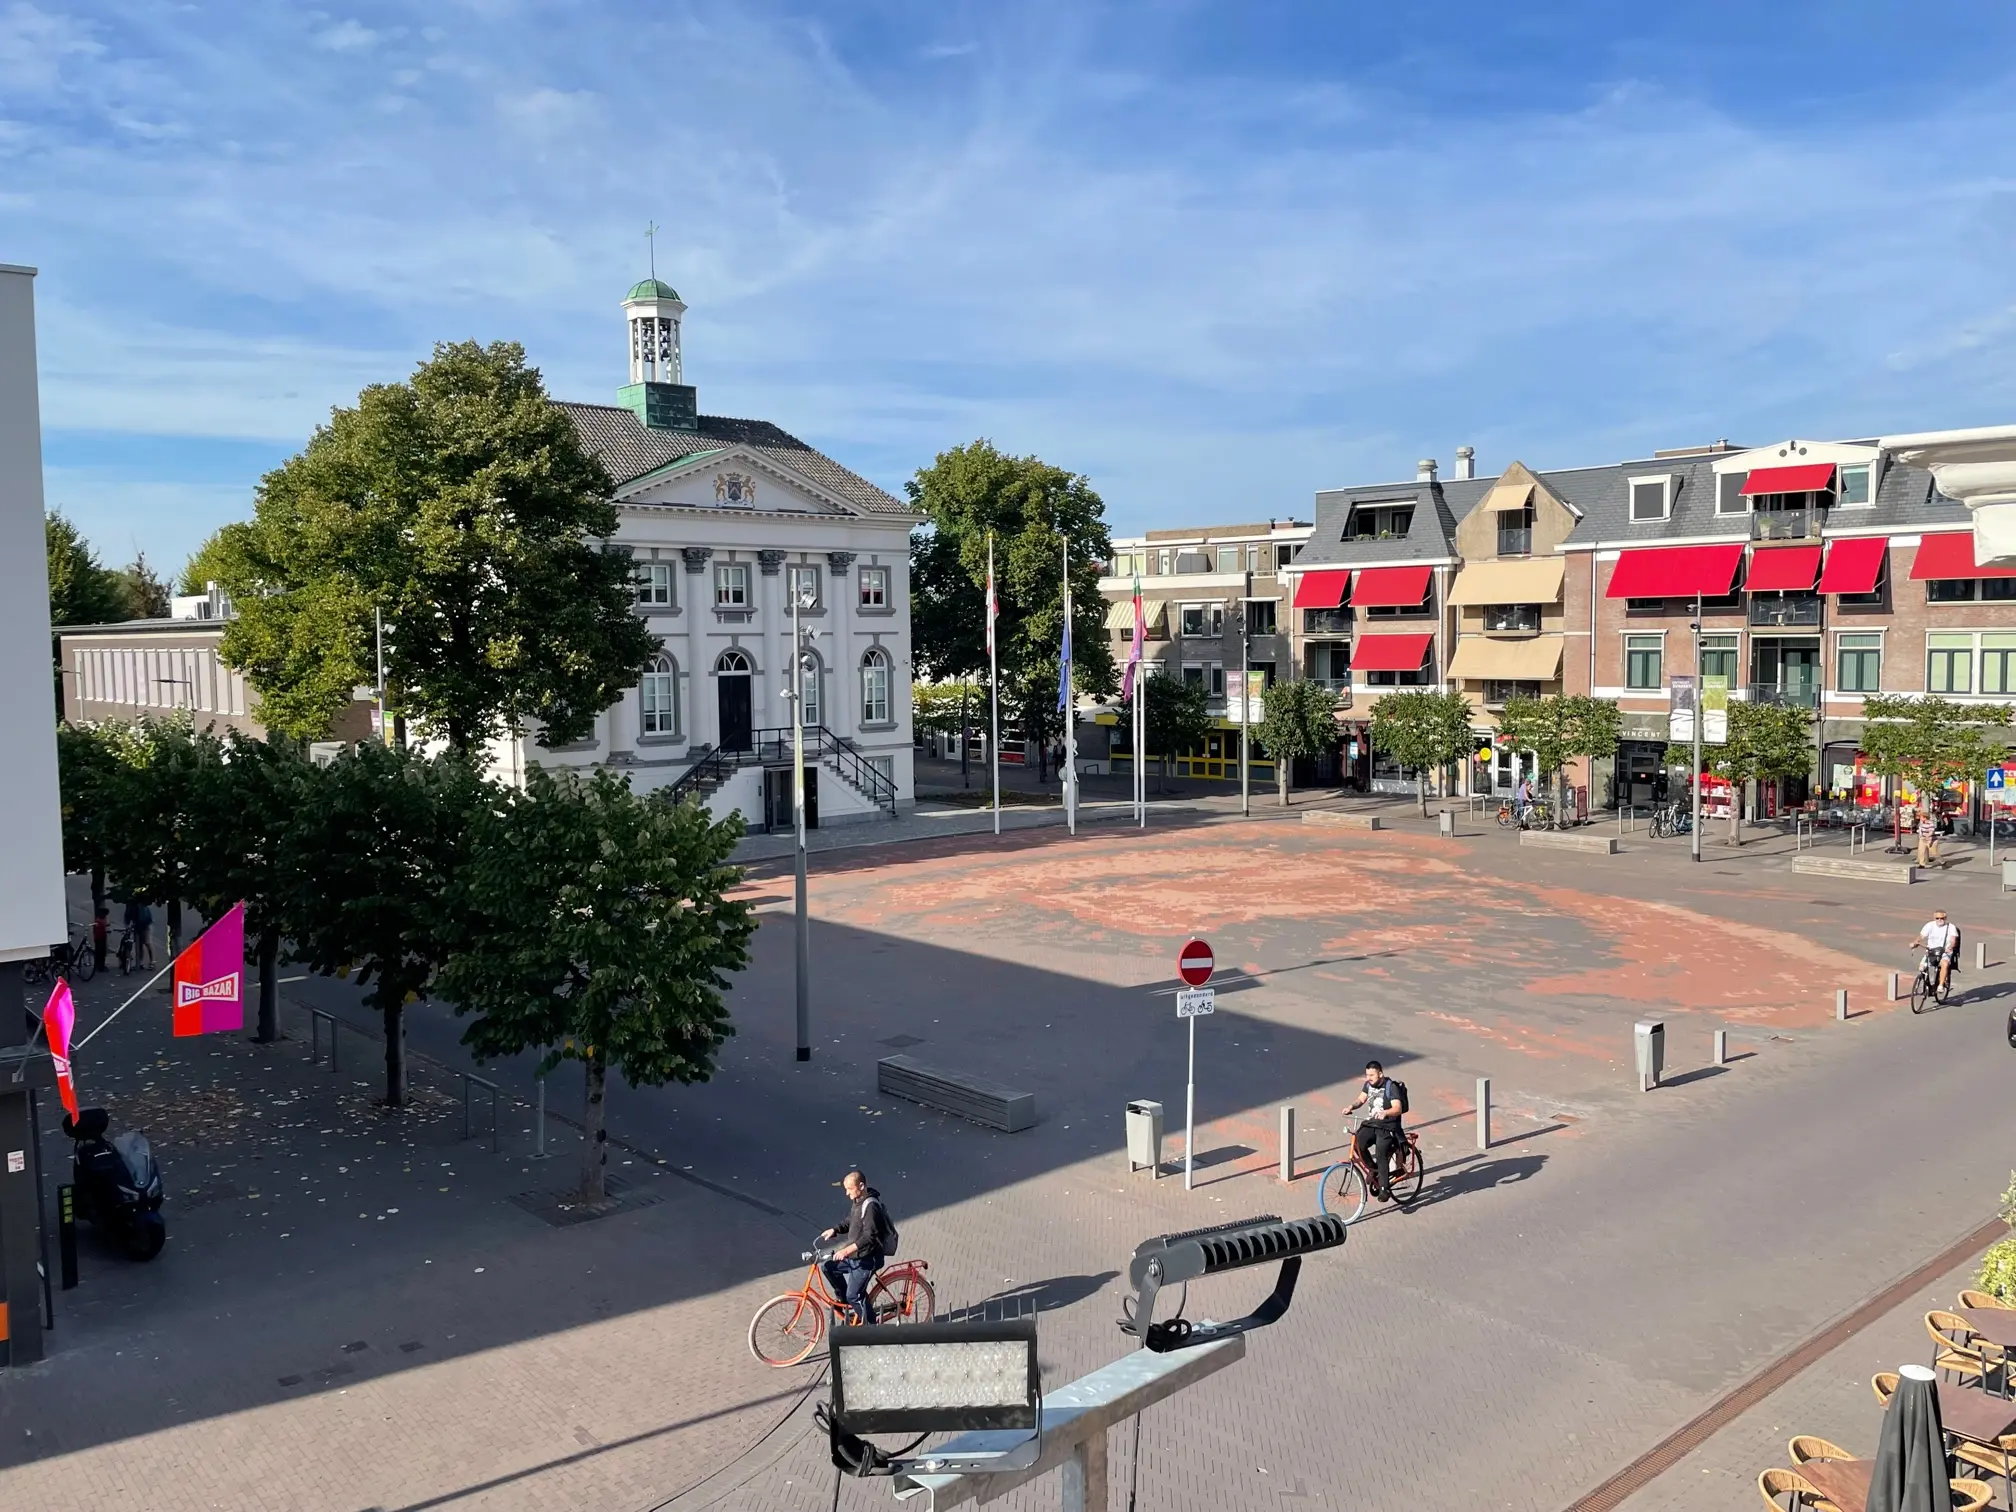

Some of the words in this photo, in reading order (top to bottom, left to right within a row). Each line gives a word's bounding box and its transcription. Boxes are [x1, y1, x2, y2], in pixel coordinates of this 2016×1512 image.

[1622, 730, 1661, 738] VINCENT
[185, 987, 200, 1001] BIG
[203, 980, 232, 997] BAZAR
